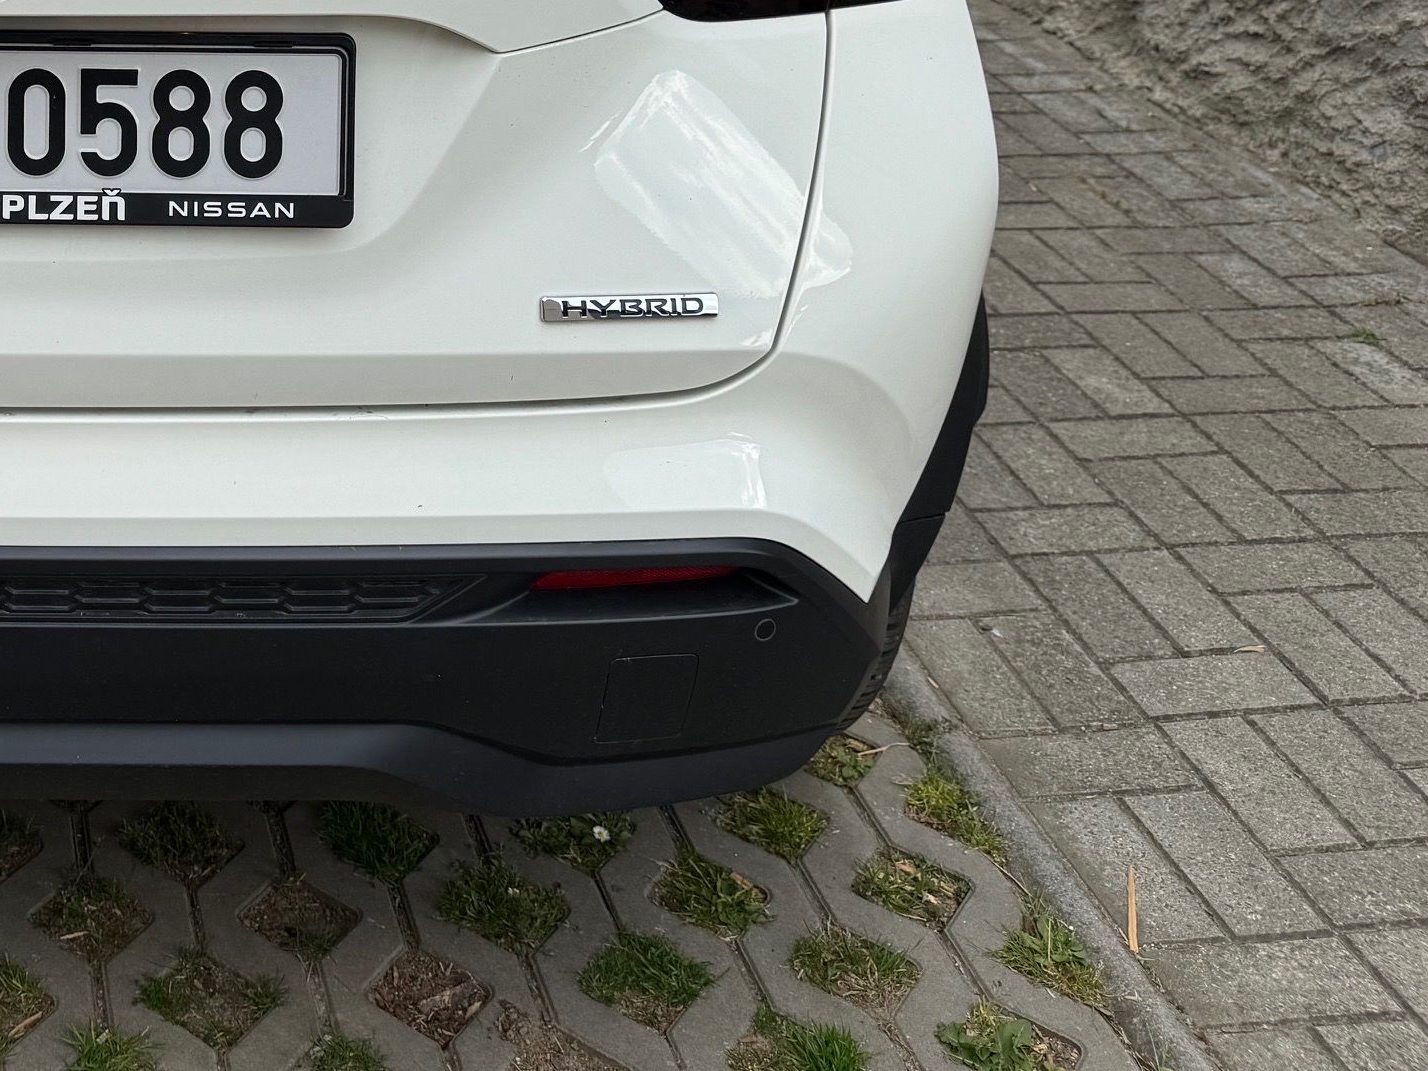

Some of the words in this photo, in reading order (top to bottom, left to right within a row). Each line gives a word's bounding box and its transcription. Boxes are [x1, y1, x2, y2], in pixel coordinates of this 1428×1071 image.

[7, 67, 284, 179] 0588
[168, 200, 295, 219] NISSAN
[561, 297, 704, 318] HYBRID
